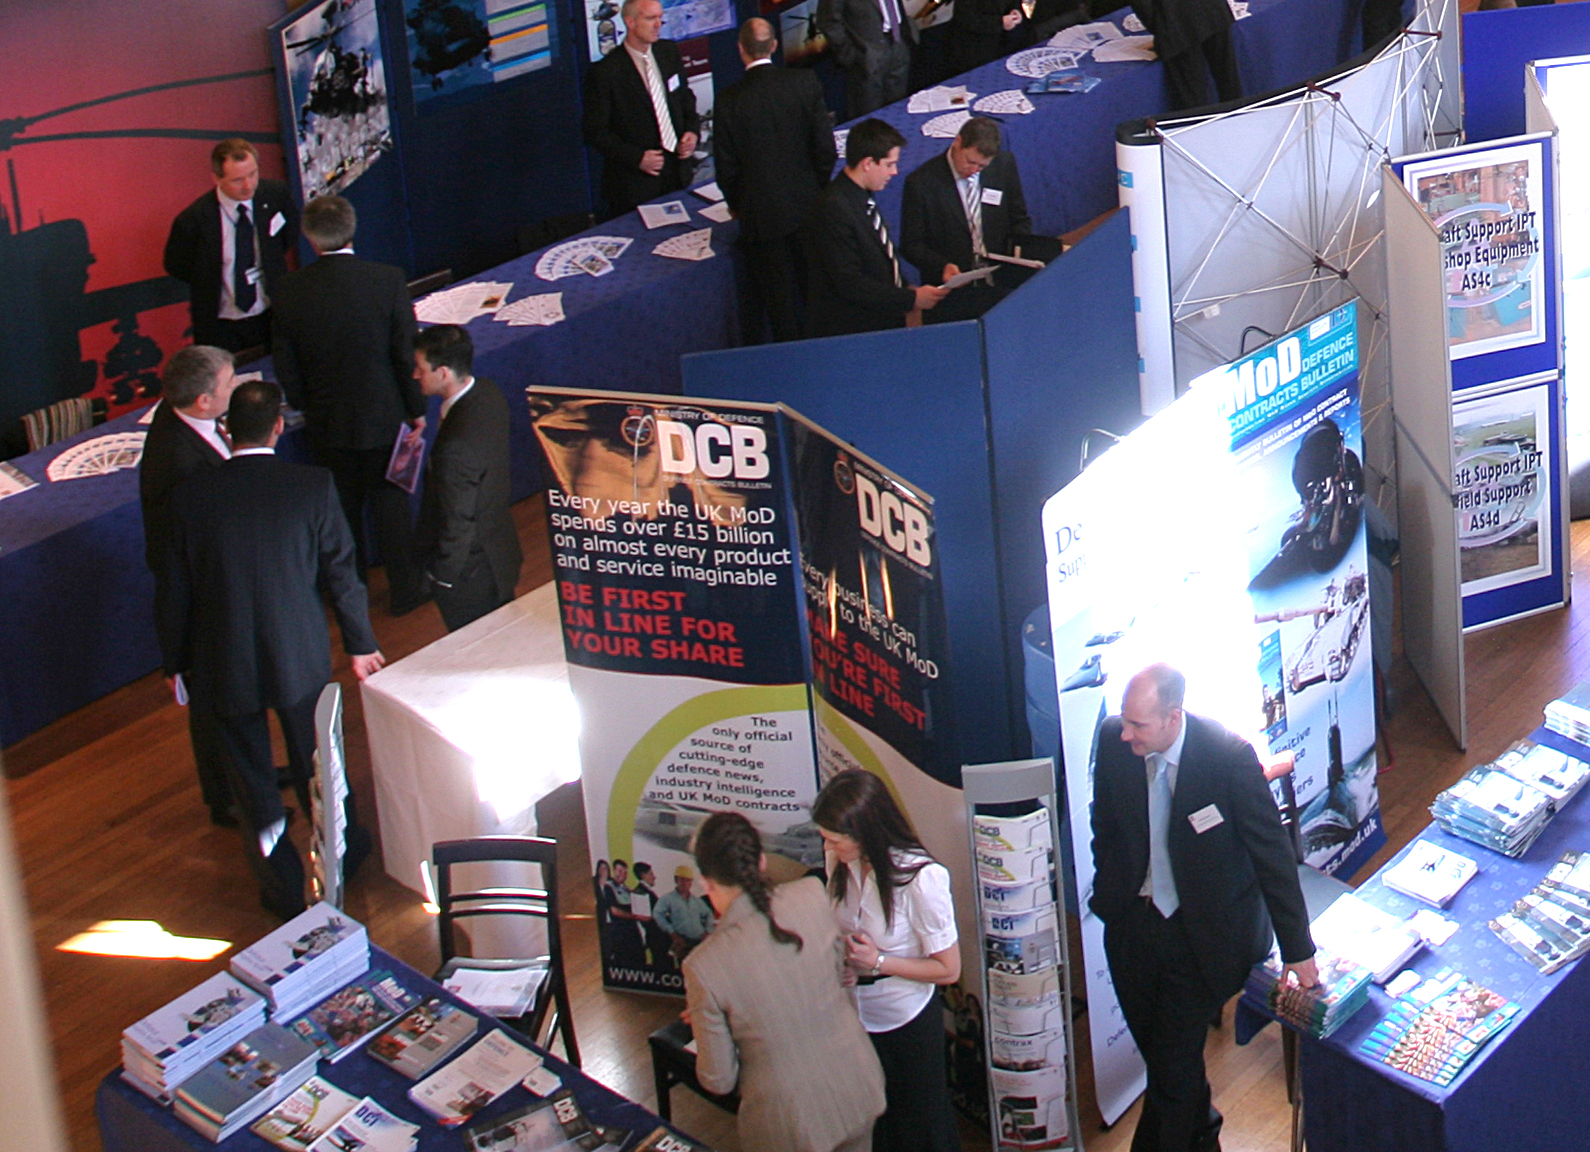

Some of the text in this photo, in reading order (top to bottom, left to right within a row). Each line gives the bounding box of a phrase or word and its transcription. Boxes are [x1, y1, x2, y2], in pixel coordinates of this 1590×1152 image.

[1465, 217, 1514, 243] Support
[1517, 211, 1537, 231] IPT
[1475, 239, 1540, 266] Equipment
[1462, 271, 1491, 291] AS4c
[1301, 332, 1354, 373] DEFENCE
[1224, 336, 1301, 417] MoD
[1229, 382, 1299, 432] CONTRACTS
[1300, 348, 1355, 391] BULLETIN
[654, 408, 700, 422] MINISTRY
[718, 412, 764, 425] DEFENCE
[656, 419, 770, 479] DCB
[1474, 457, 1521, 483] Support
[1524, 451, 1543, 470] IPT
[548, 489, 776, 524] Every year the UK MoD
[1485, 480, 1531, 505] Support
[551, 512, 775, 545] spends over £15 billion
[855, 472, 932, 567] DCB
[1470, 509, 1500, 532] AS4d
[554, 532, 792, 566] on almost every product
[556, 552, 778, 587] and service imaginable
[560, 580, 688, 612] BE FIRST
[563, 605, 738, 643] IN LINE FOR
[891, 621, 917, 647] can
[566, 628, 746, 668] YOUR SHARE
[838, 602, 855, 624] to
[858, 614, 881, 642] the
[882, 630, 903, 659] UK
[905, 647, 939, 679] MoD
[852, 641, 901, 691] SURE
[829, 671, 876, 718] LINE
[872, 676, 927, 731] FIRST
[712, 726, 793, 742] only official
[751, 716, 777, 728] The
[678, 750, 765, 770] cutting-edge
[690, 737, 752, 754] source of
[655, 776, 797, 798] industry intelligence
[667, 763, 764, 785] defence news,
[649, 790, 800, 812] and UK MoD contracts
[608, 967, 683, 987] www.co
[553, 1096, 579, 1125] DCB
